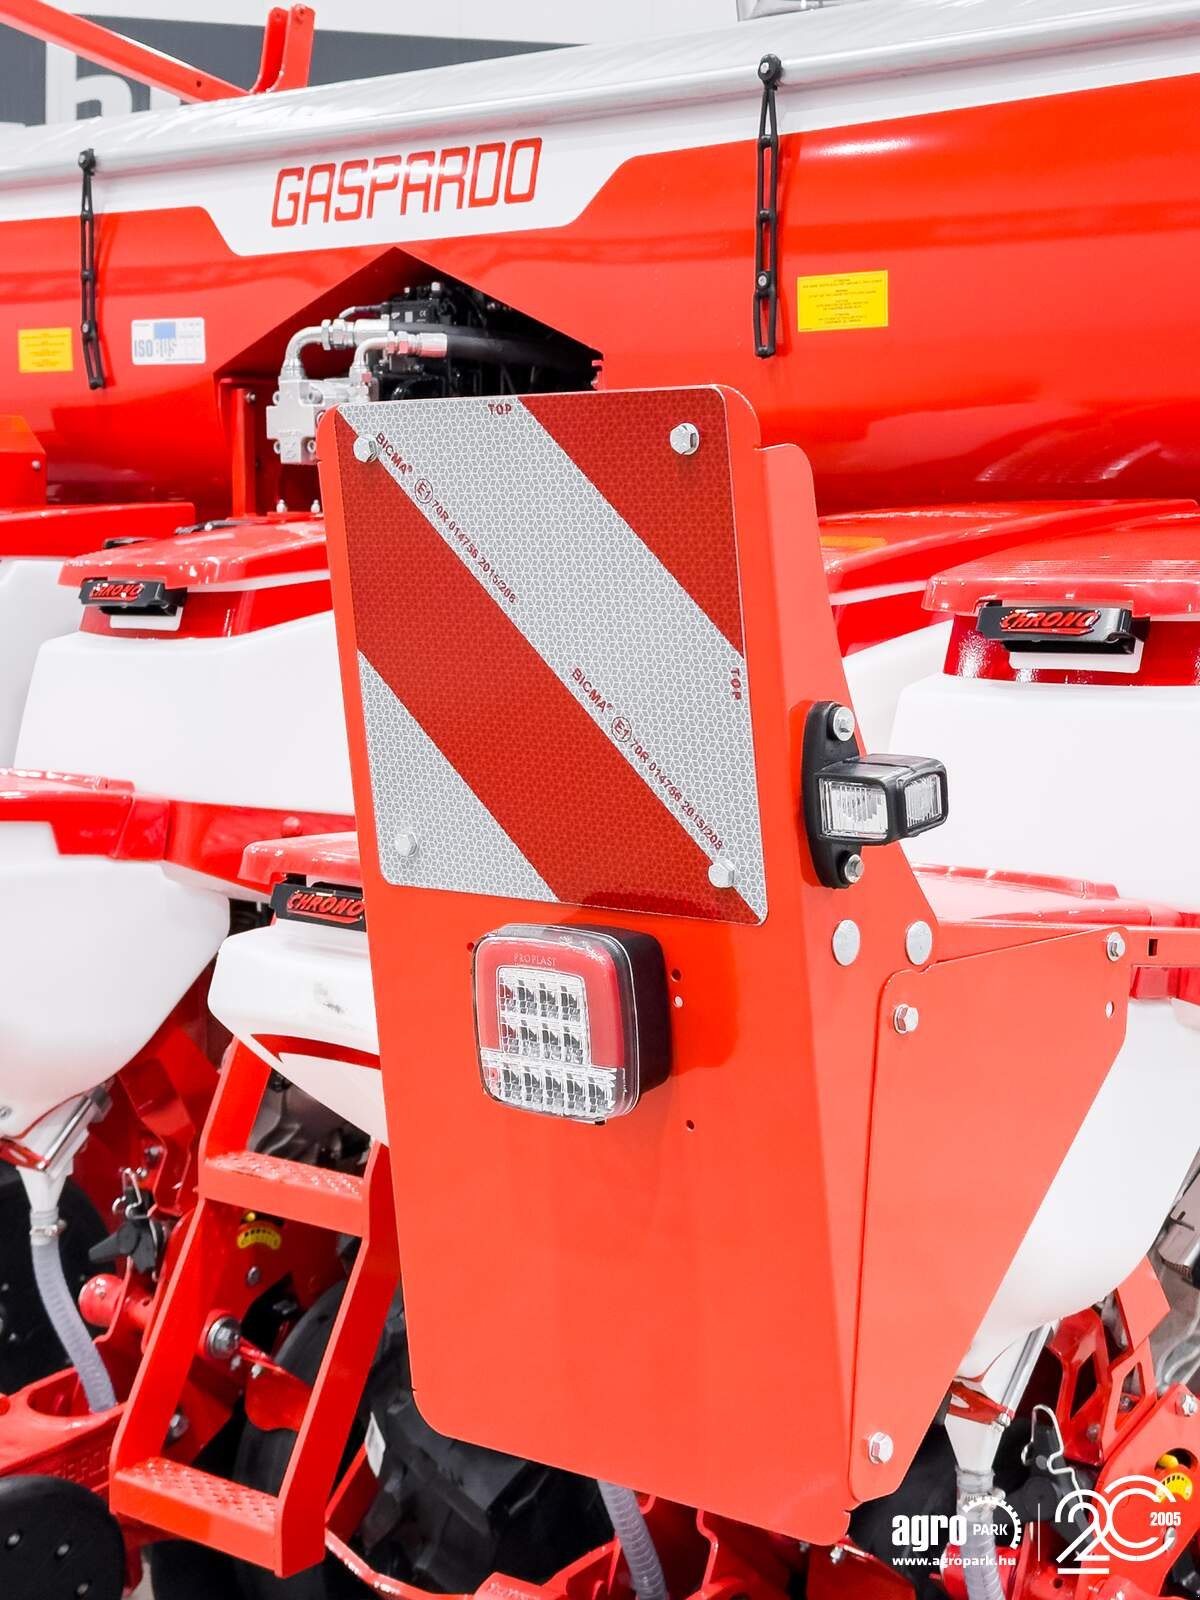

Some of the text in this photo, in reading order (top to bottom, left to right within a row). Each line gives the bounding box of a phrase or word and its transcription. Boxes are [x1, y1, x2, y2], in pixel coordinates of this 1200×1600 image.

[271, 137, 542, 227] GASPARDO
[487, 403, 513, 415] TOP
[432, 500, 449, 523] 70R
[448, 521, 479, 559] 014756
[478, 557, 516, 603] 2015/208
[1001, 610, 1101, 629] CHRONO
[730, 667, 742, 700] TOP
[630, 738, 650, 763] 70R
[648, 762, 682, 801] 014756
[680, 801, 724, 850] 2015/208
[287, 892, 365, 917] CHRONO
[513, 952, 556, 967] PROPLAST
